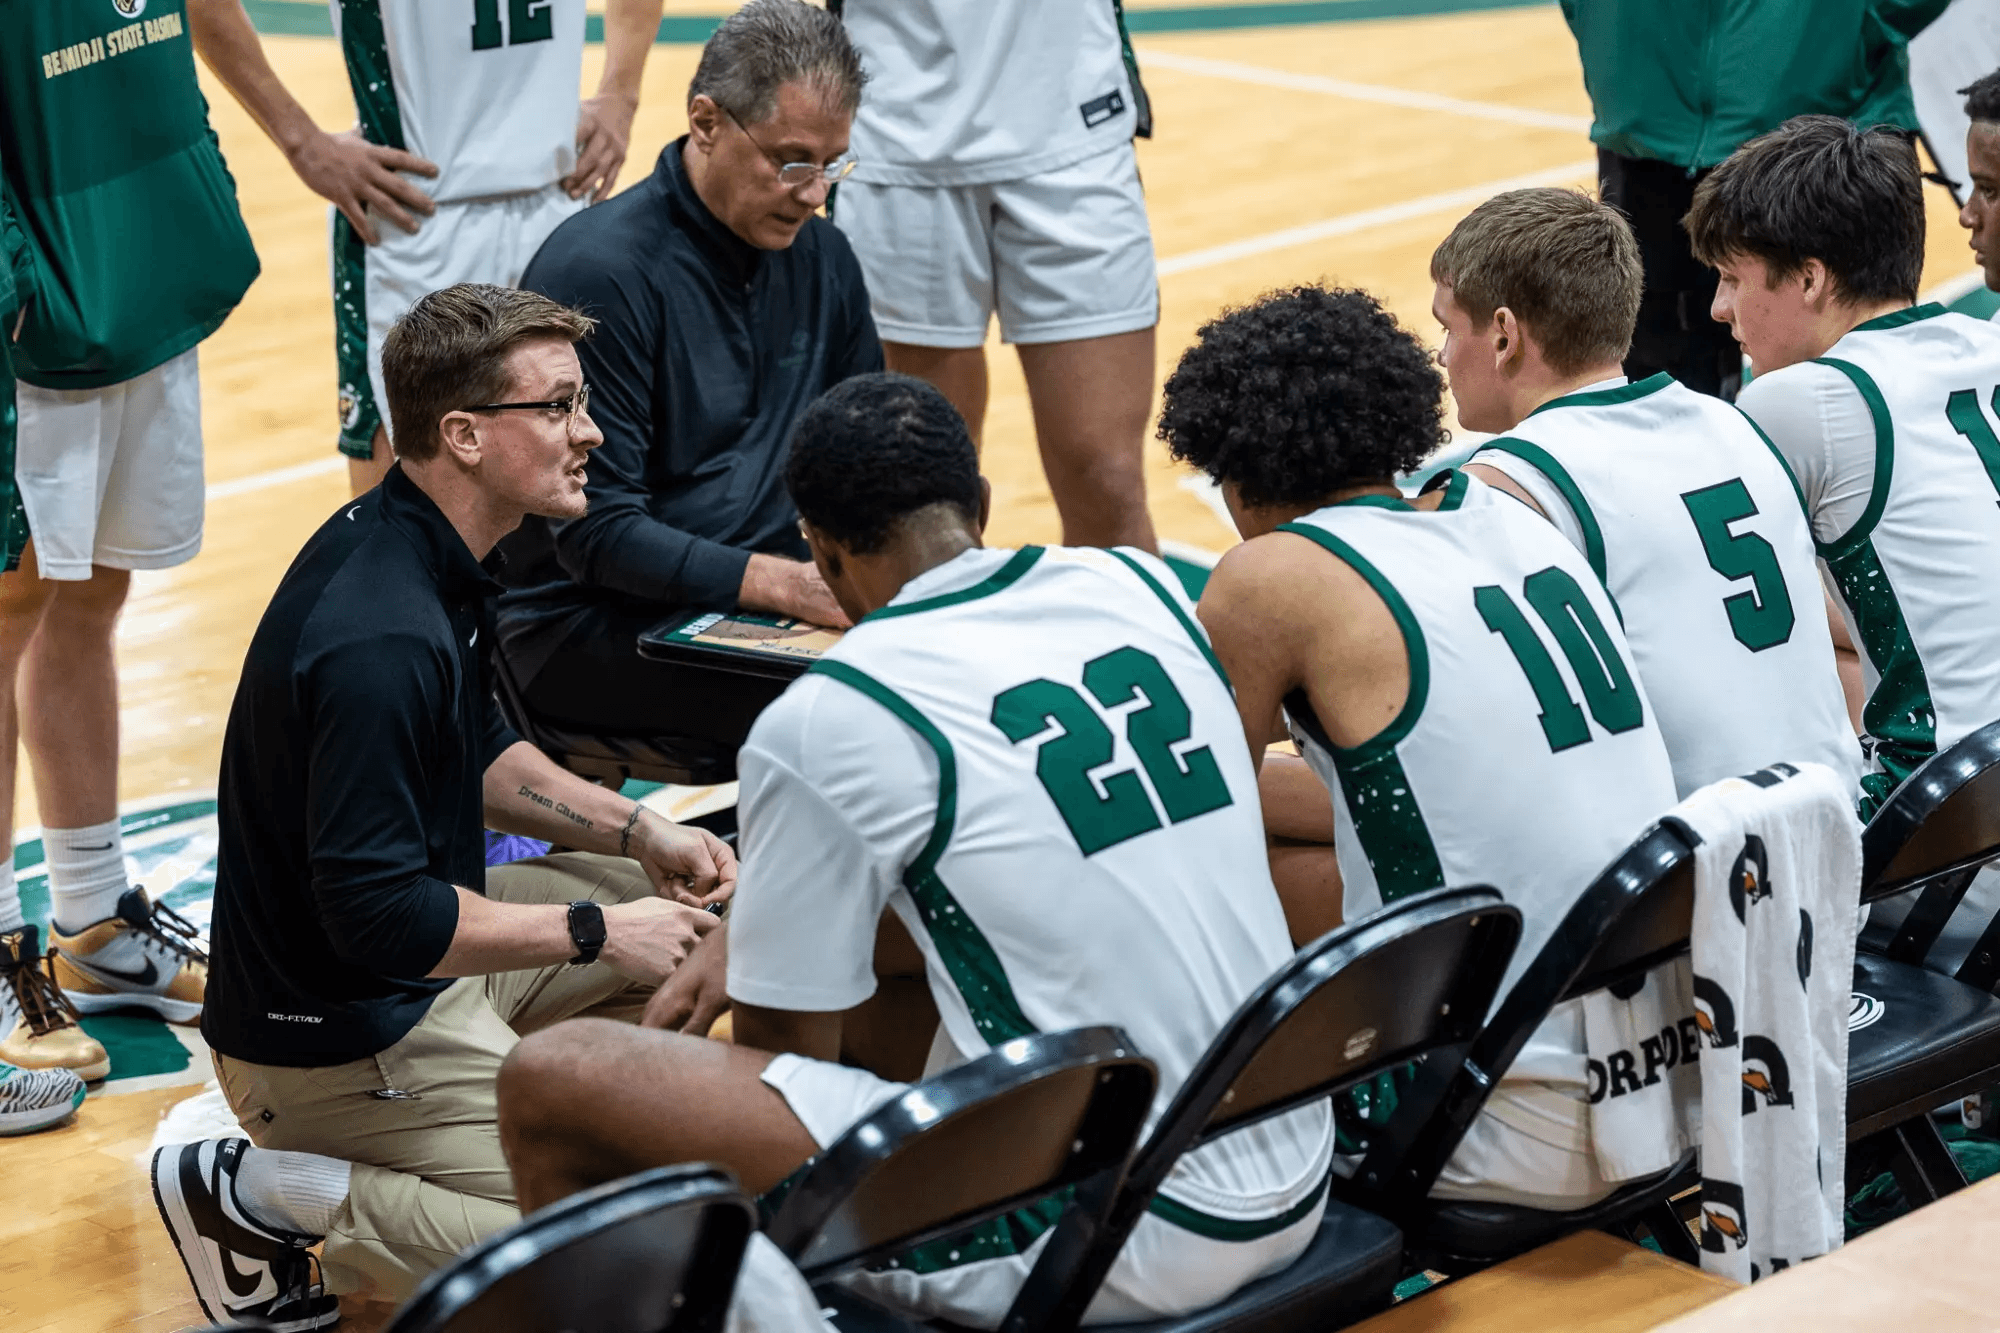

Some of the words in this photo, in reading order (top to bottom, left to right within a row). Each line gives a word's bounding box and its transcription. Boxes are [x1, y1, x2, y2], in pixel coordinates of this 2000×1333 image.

[42, 36, 106, 79] BEMIDJI
[106, 22, 145, 57] STATE
[1681, 477, 1796, 652] 5
[1474, 565, 1644, 753] 10
[518, 785, 553, 809] Dream
[555, 802, 594, 829] Chaser
[990, 645, 1234, 857] 22
